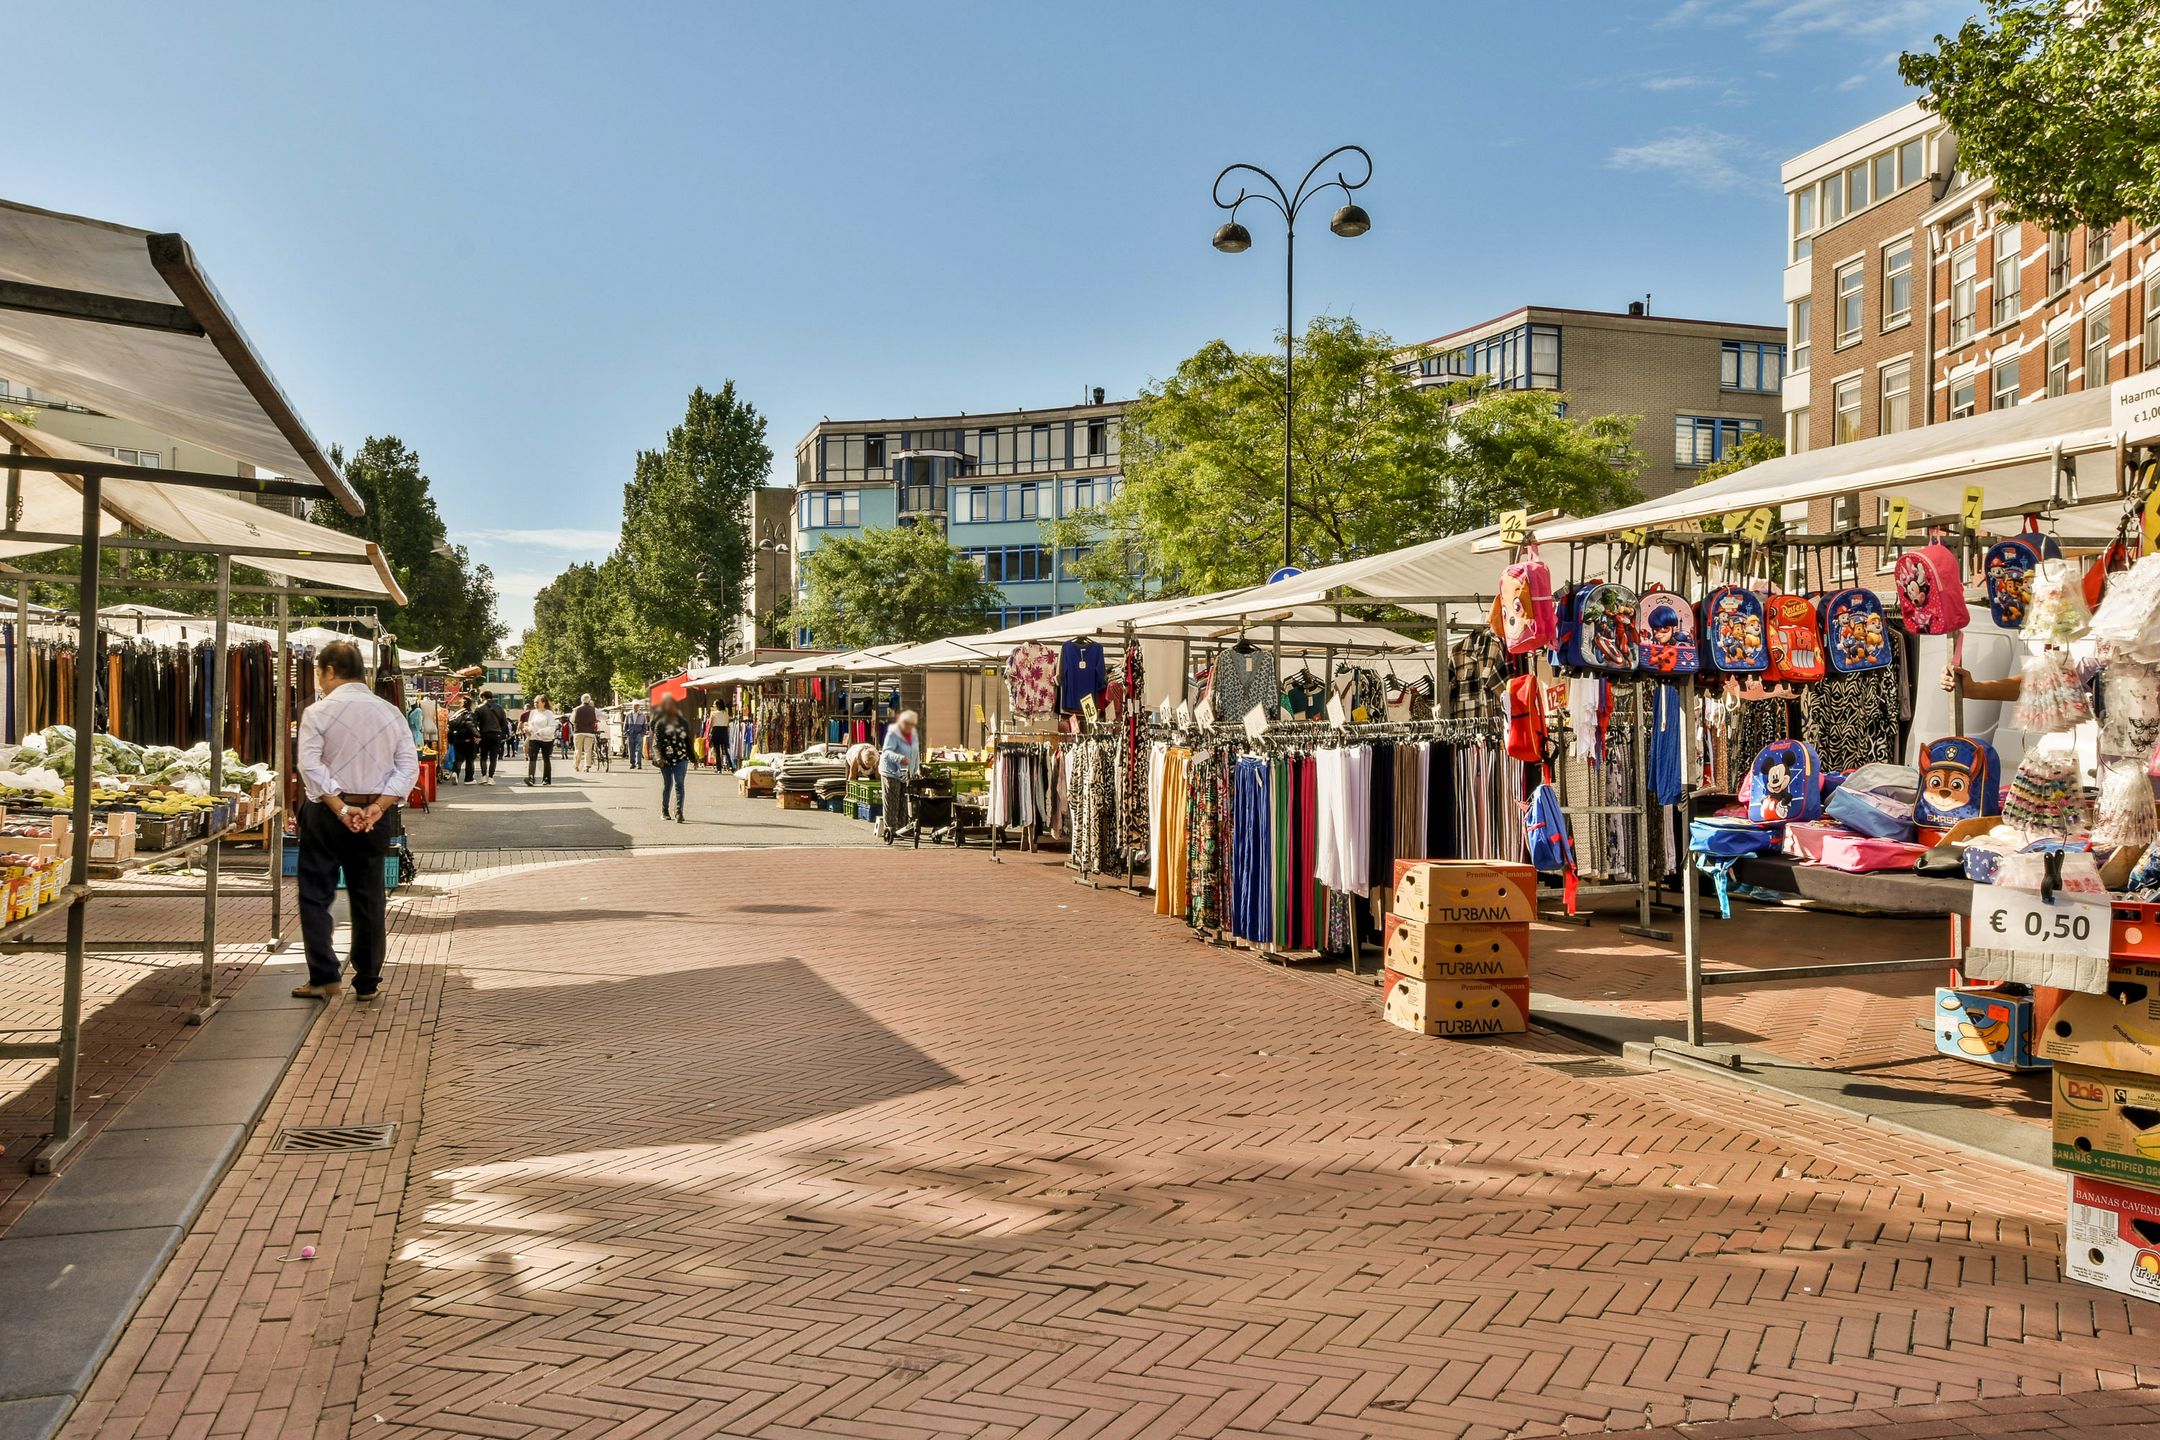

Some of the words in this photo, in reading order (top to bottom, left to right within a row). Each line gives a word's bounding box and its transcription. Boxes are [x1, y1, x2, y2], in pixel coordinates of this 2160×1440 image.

[2133, 414, 2140, 423] €
[1440, 906, 1511, 921] TURBANA
[1989, 909, 2008, 933] €
[2024, 911, 2091, 942] 0,50
[1436, 961, 1504, 976] TURBANA
[1435, 1018, 1504, 1034] TURBANA
[2068, 1081, 2104, 1099] Dole
[2053, 1149, 2092, 1165] BANANAS
[2100, 1157, 2144, 1174] CERTIFIED
[2075, 1190, 2120, 1208] BANANAS
